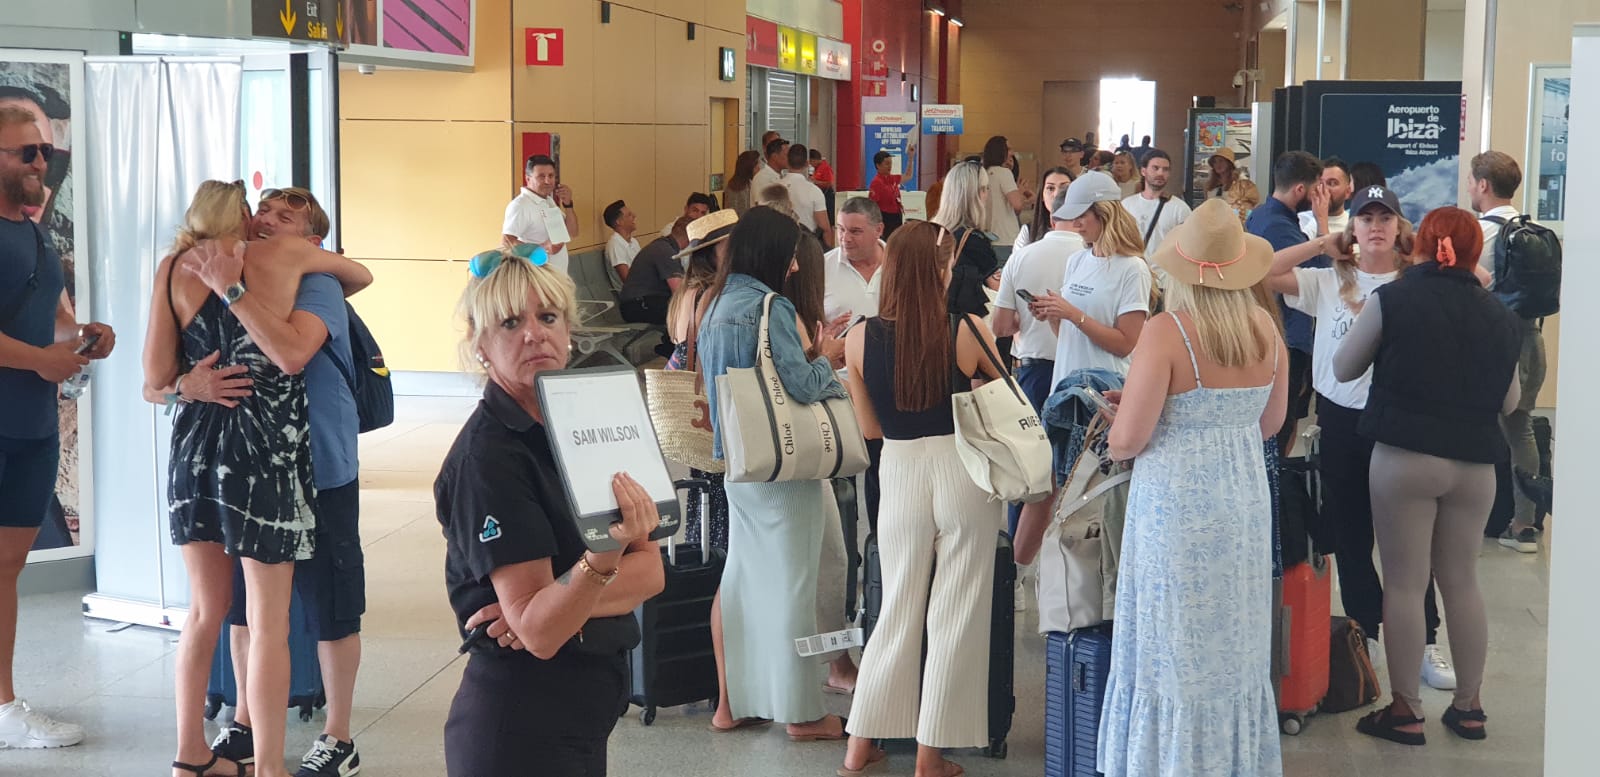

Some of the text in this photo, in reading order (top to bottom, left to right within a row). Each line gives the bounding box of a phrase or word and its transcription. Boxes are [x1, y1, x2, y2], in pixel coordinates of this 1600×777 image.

[306, 1, 318, 18] Exit
[307, 20, 329, 39] Salida
[1388, 104, 1440, 115] Aeropuerto
[1427, 113, 1439, 122] de
[1387, 118, 1440, 139] Ibiza
[771, 376, 785, 406] Chloé
[572, 424, 641, 446] SAM WILSON
[782, 423, 796, 455] Chloé
[820, 421, 833, 454] Chloé
